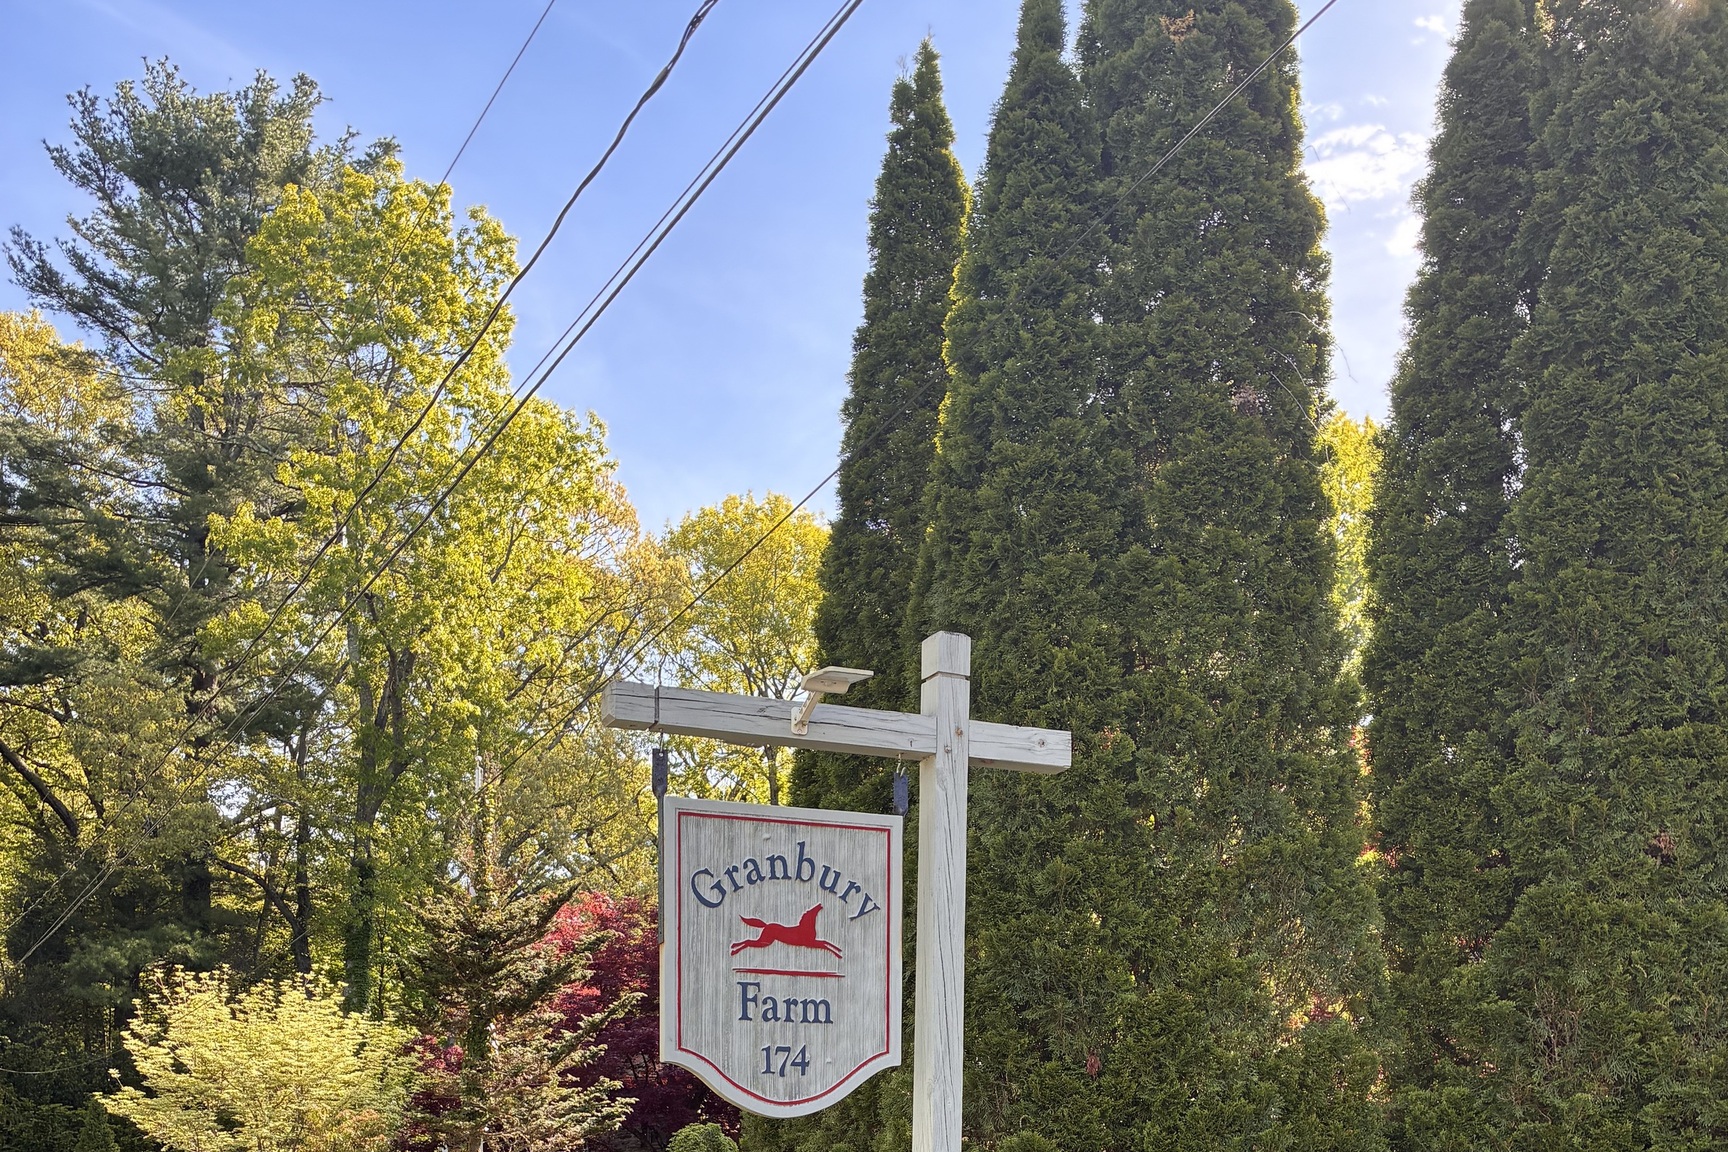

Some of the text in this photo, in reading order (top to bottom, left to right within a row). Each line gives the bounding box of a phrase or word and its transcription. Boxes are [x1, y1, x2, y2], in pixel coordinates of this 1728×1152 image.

[690, 841, 881, 921] Granbury
[737, 981, 834, 1024] Farm
[761, 1044, 810, 1077] 174
